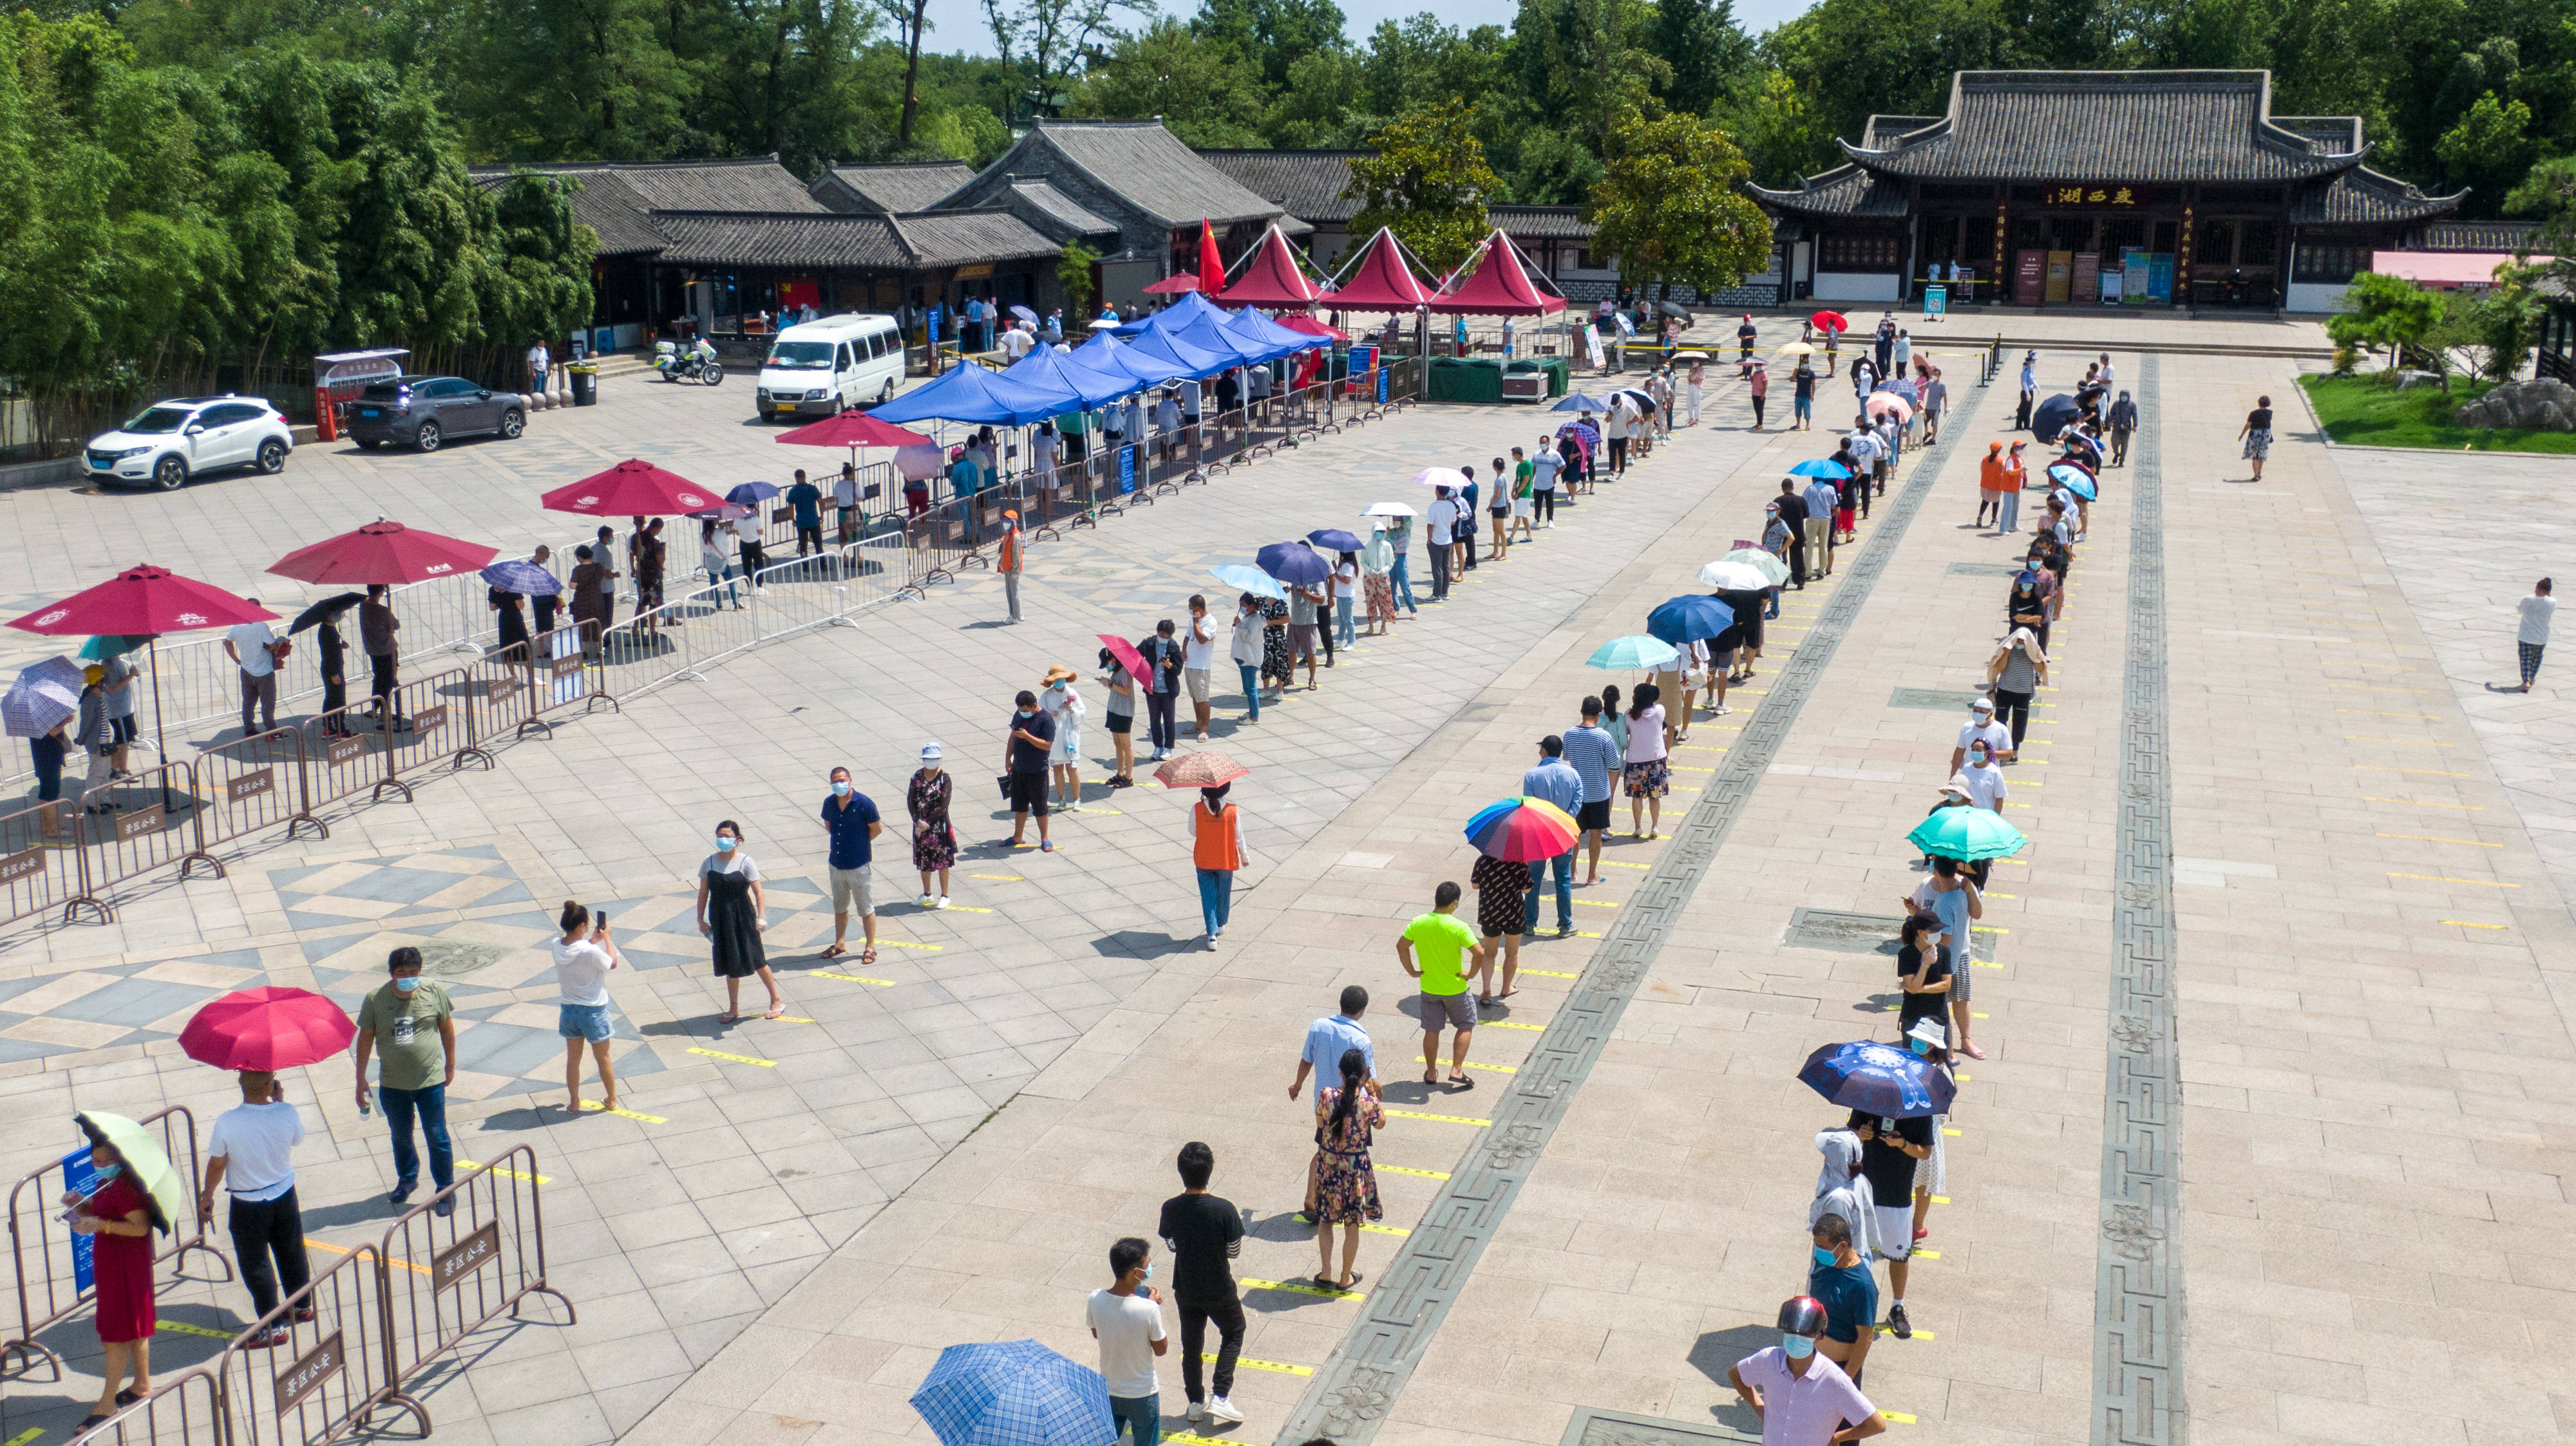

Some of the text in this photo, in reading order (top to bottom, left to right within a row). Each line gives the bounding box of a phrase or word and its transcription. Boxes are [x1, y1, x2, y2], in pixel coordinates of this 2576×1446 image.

[2059, 187, 2135, 204] 瘦西湖
[335, 743, 359, 759] 景区公安
[236, 778, 266, 794] 景区公安
[125, 815, 156, 834] 景区公安
[1, 858, 36, 878] 景区公安
[444, 1239, 486, 1277] 景区公安
[286, 1353, 330, 1397] 景区公安
